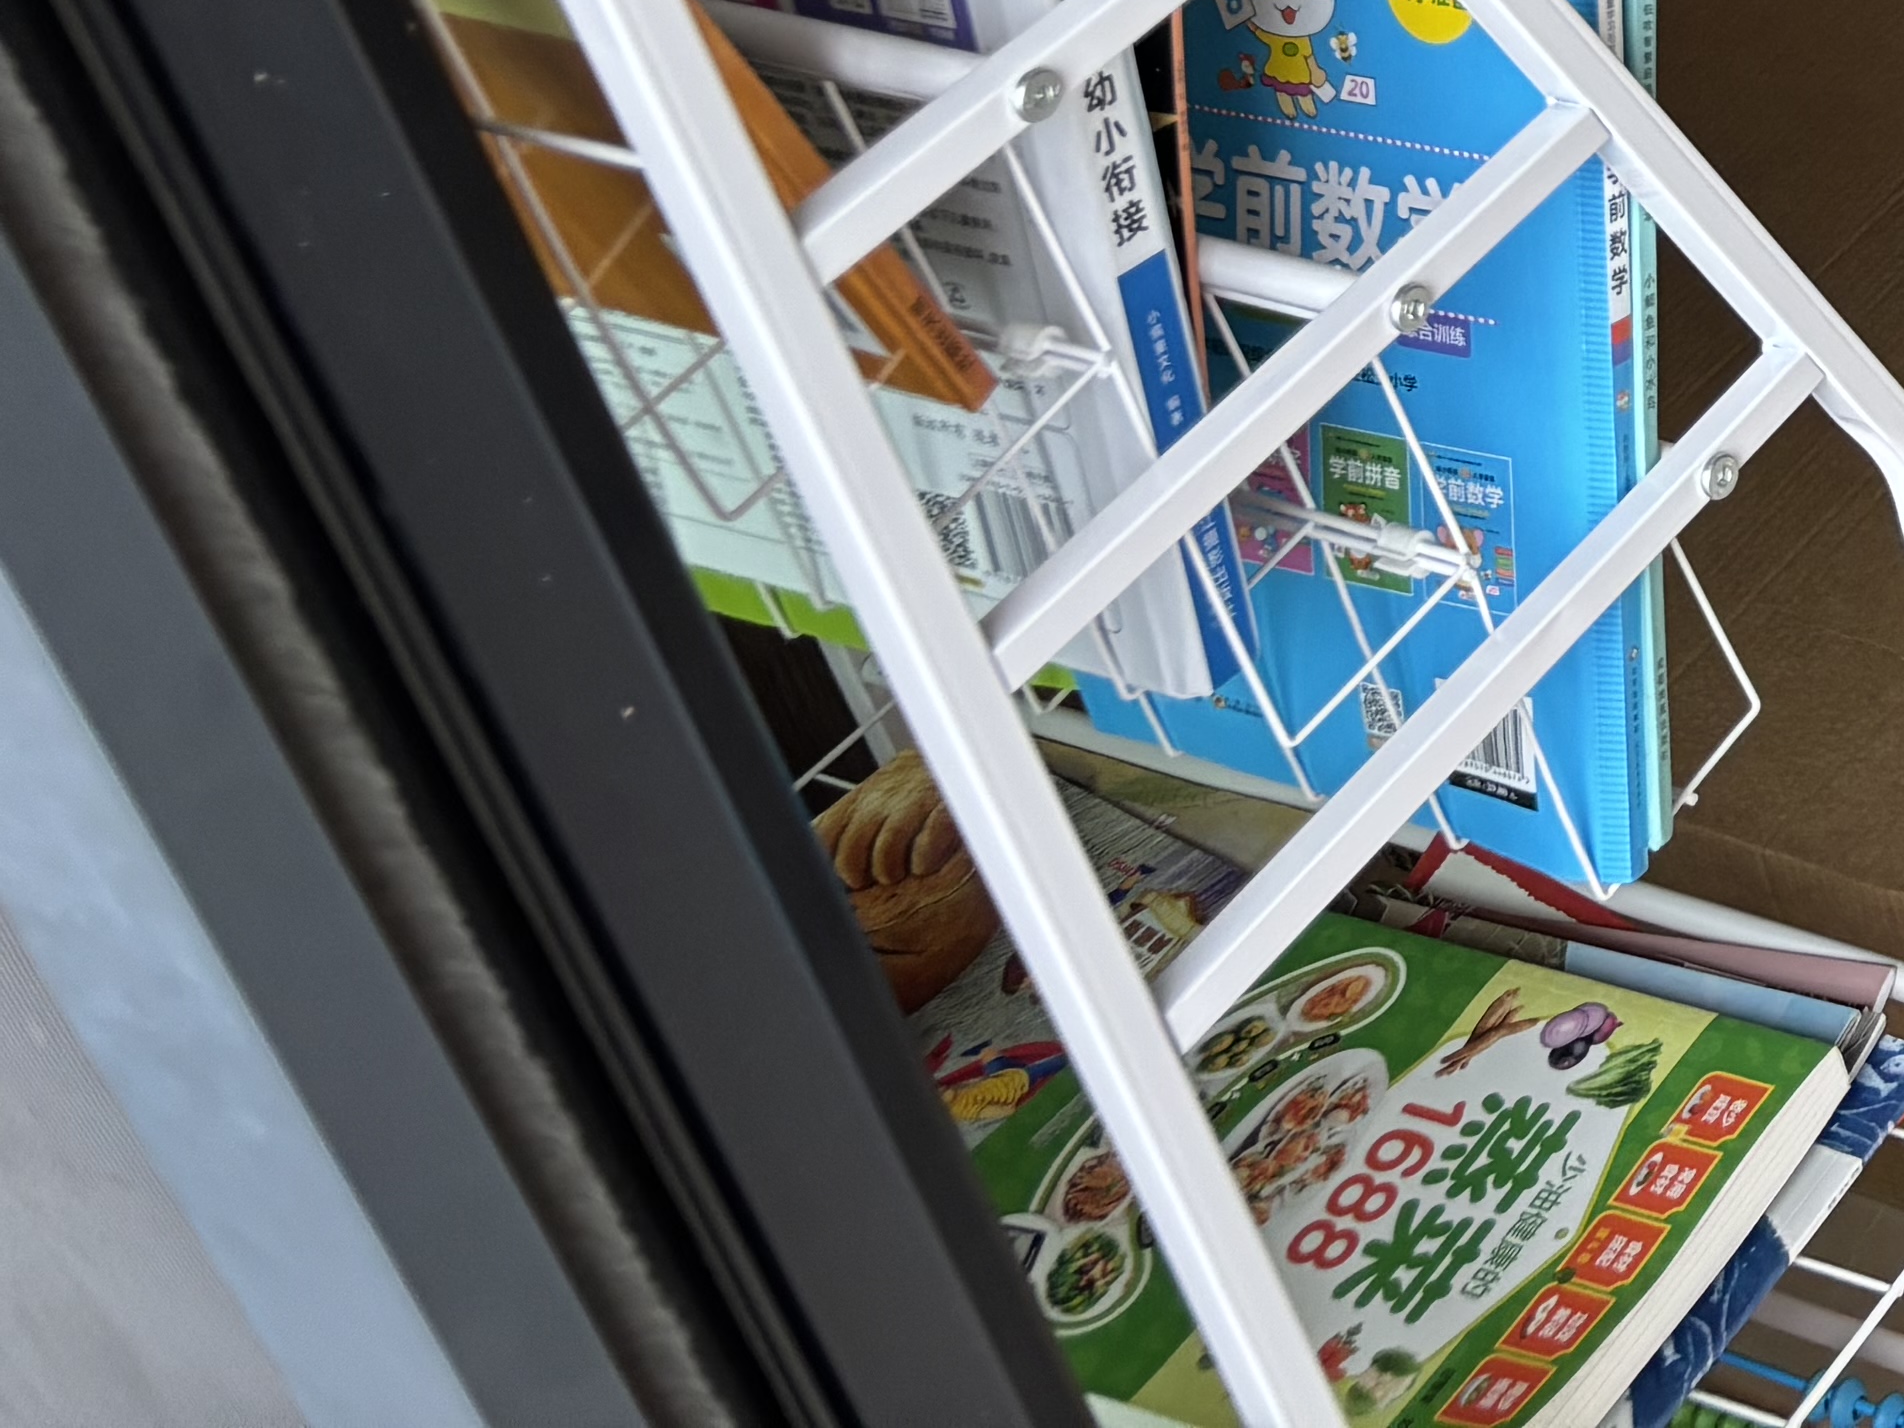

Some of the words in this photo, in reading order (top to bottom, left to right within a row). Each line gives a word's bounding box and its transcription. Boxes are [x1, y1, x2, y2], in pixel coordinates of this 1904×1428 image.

[1346, 77, 1371, 100] 20
[1285, 1099, 1466, 1270] 1688
[1333, 1090, 1584, 1324] 蒸菜
[1459, 1152, 1591, 1302] 少油健康的
